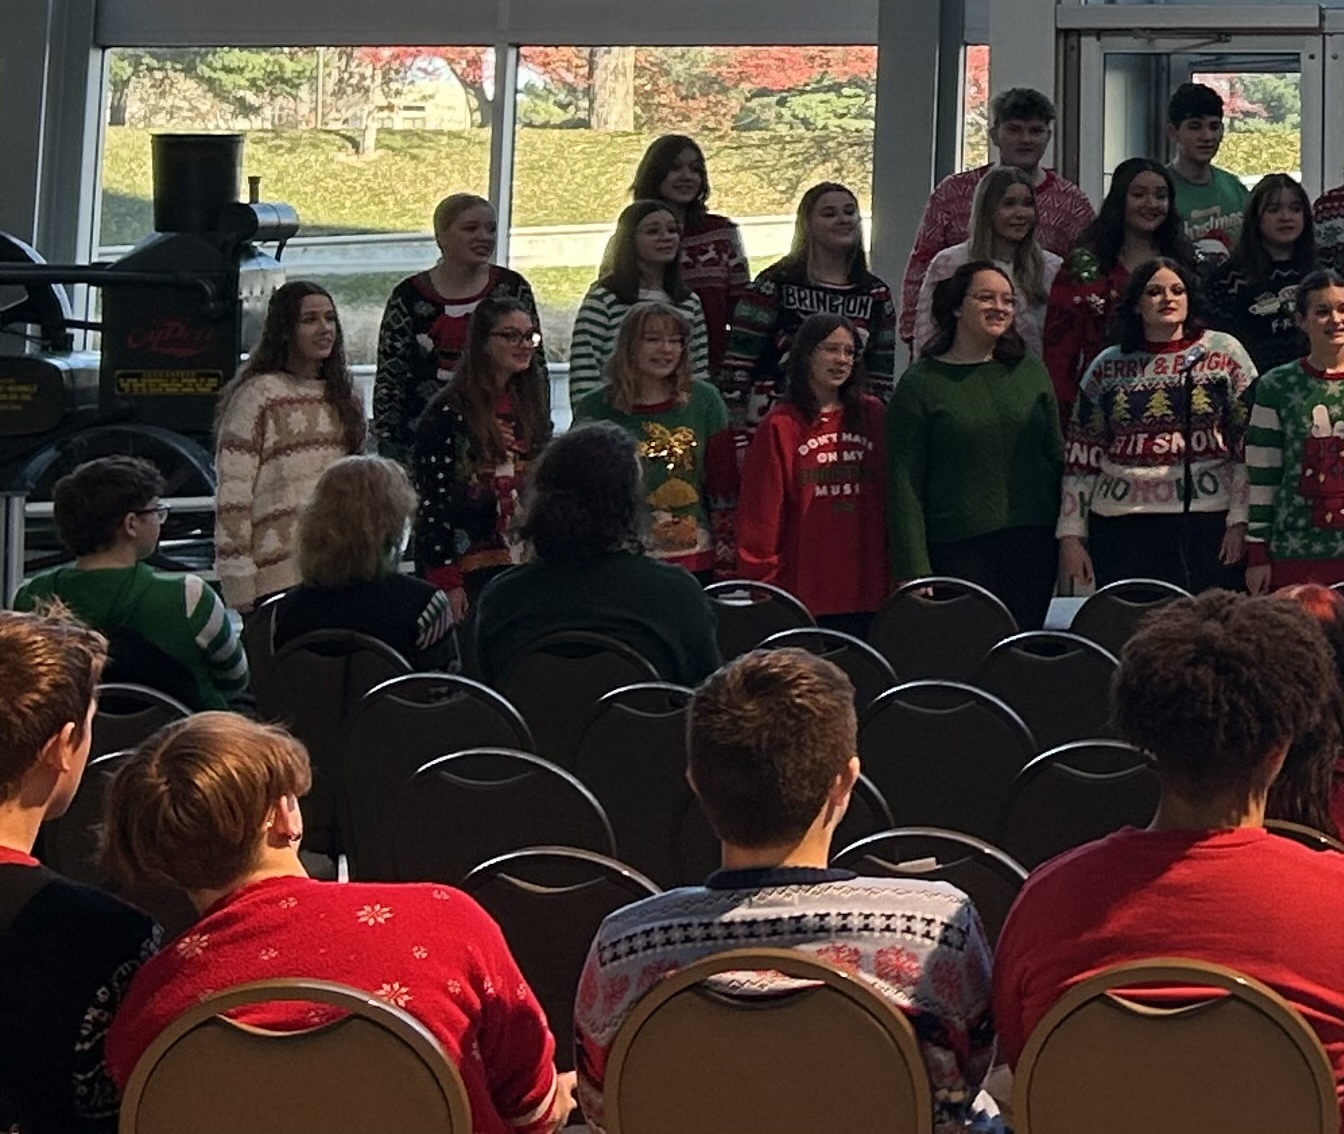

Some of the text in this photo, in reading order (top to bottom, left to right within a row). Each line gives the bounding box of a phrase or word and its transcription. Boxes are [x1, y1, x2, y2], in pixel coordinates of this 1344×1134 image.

[843, 295, 873, 319] ON
[1153, 356, 1168, 375] &
[816, 451, 838, 464] ON
